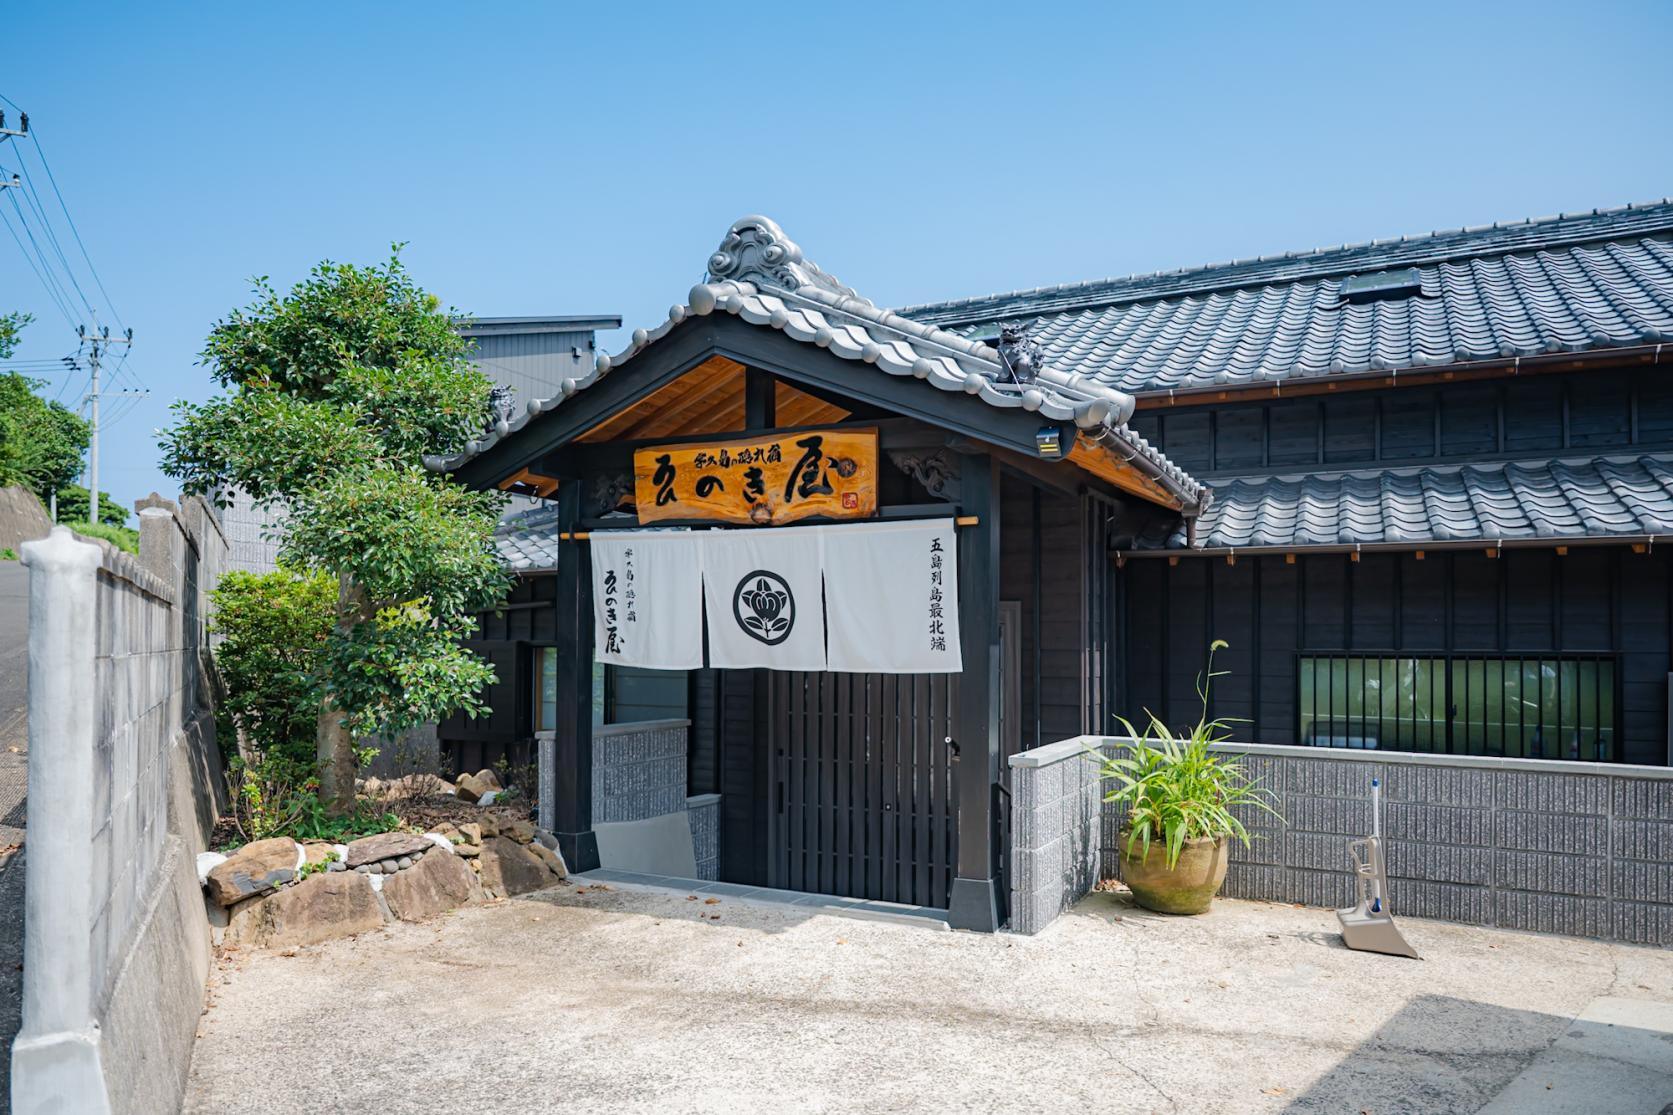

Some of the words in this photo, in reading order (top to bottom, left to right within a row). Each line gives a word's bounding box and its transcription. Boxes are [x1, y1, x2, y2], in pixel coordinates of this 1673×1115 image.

[928, 537, 946, 651] 五島列島最北端
